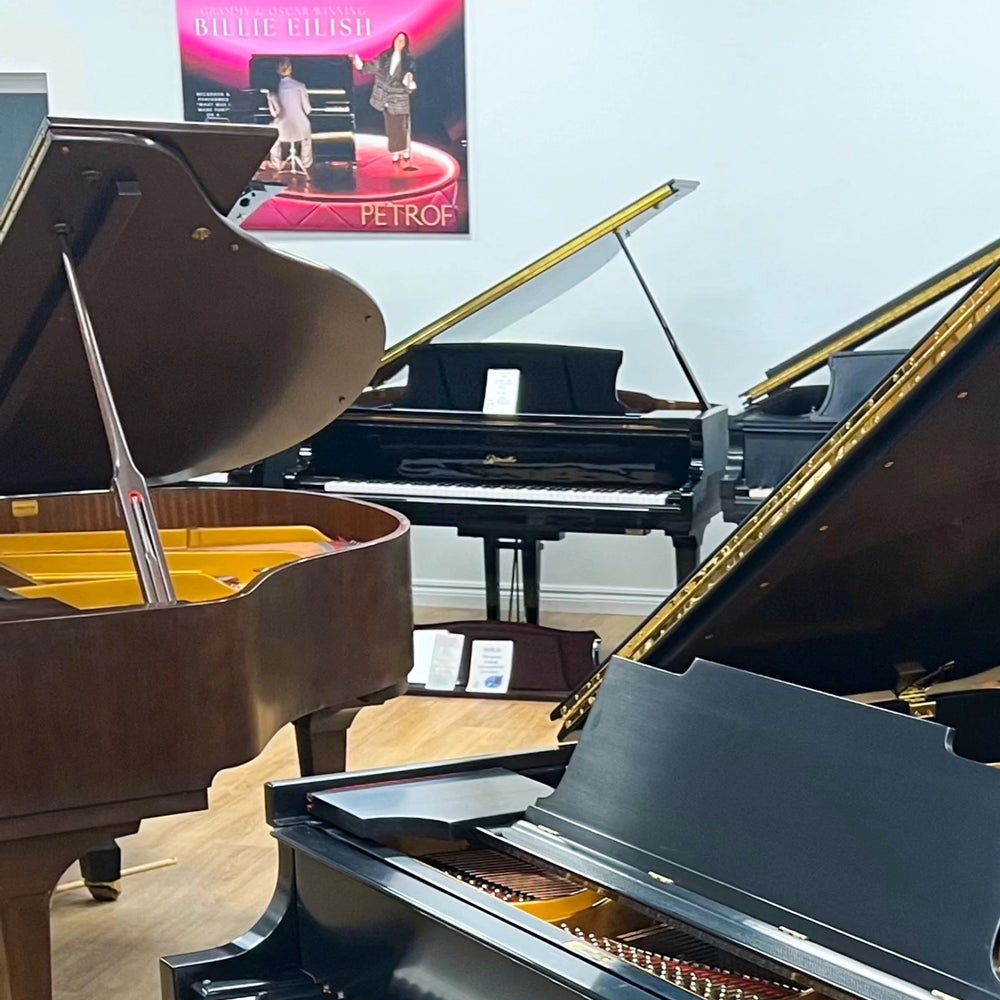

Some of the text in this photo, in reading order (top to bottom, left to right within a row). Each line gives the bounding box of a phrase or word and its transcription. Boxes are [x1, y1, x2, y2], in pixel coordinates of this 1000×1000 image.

[195, 17, 372, 37] BILLIE EILISH
[360, 203, 454, 227] PETROF
